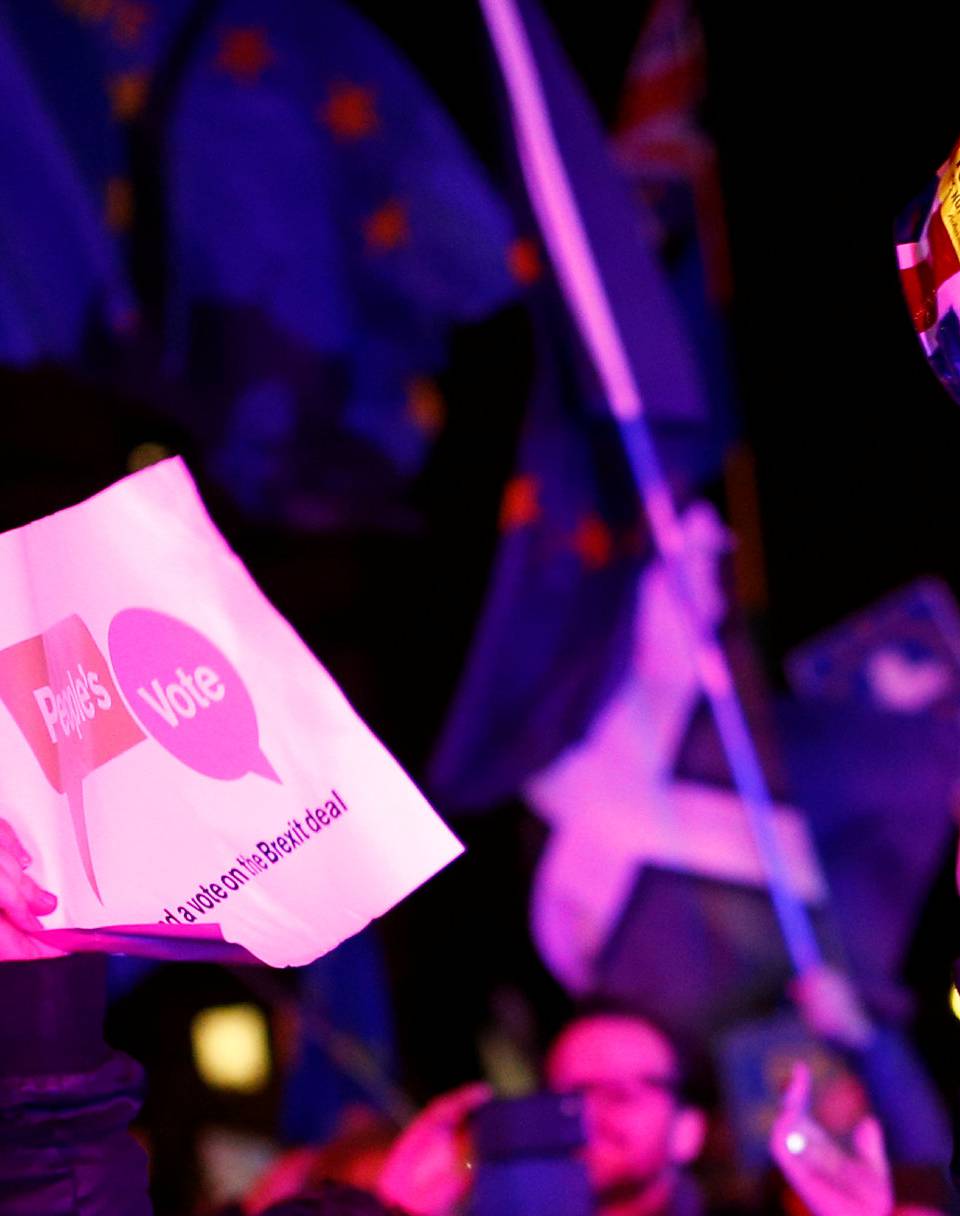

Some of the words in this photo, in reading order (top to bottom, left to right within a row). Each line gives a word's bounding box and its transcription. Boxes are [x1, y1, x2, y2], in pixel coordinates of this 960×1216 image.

[137, 666, 226, 728] Vote
[177, 906, 197, 922] a
[187, 885, 228, 914] vote
[221, 867, 250, 890] on
[236, 855, 268, 876] the
[256, 819, 310, 864] Brexit
[305, 789, 348, 833] deal
